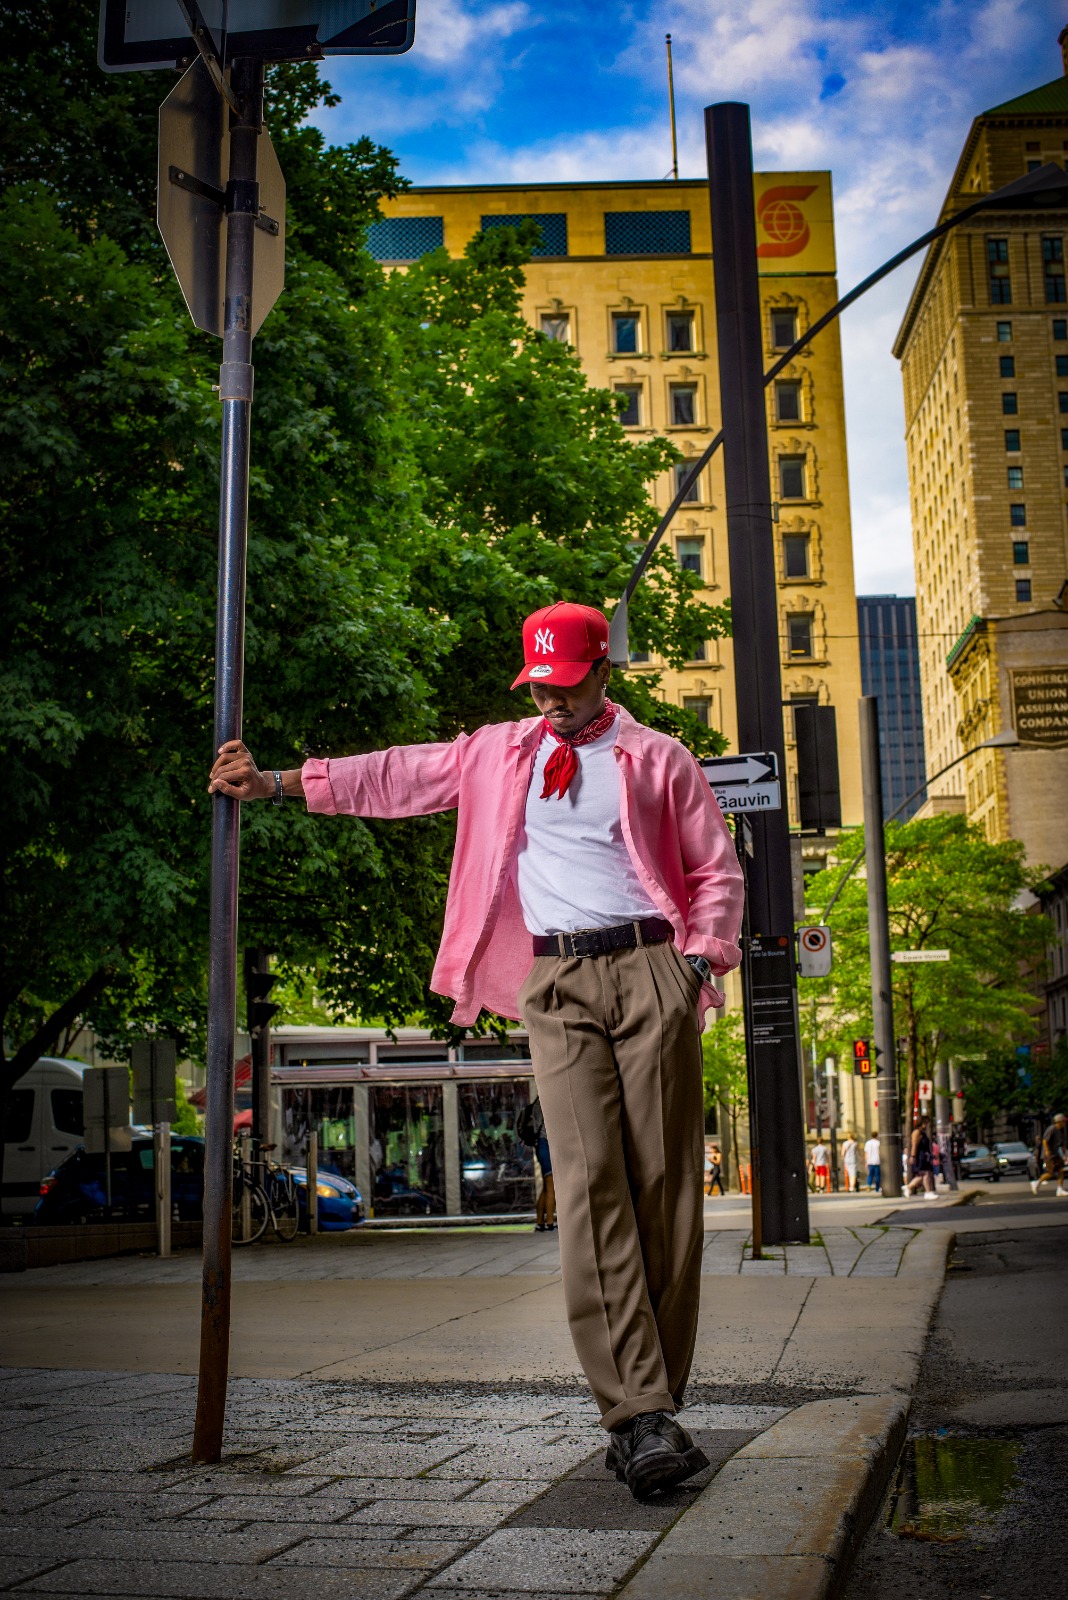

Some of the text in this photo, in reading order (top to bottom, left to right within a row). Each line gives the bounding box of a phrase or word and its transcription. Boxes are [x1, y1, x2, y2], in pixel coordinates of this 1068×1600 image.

[534, 627, 555, 655] NY
[1014, 674, 1068, 686] COMMERCI
[1028, 688, 1067, 700] UNION
[716, 793, 770, 809] Gauvin
